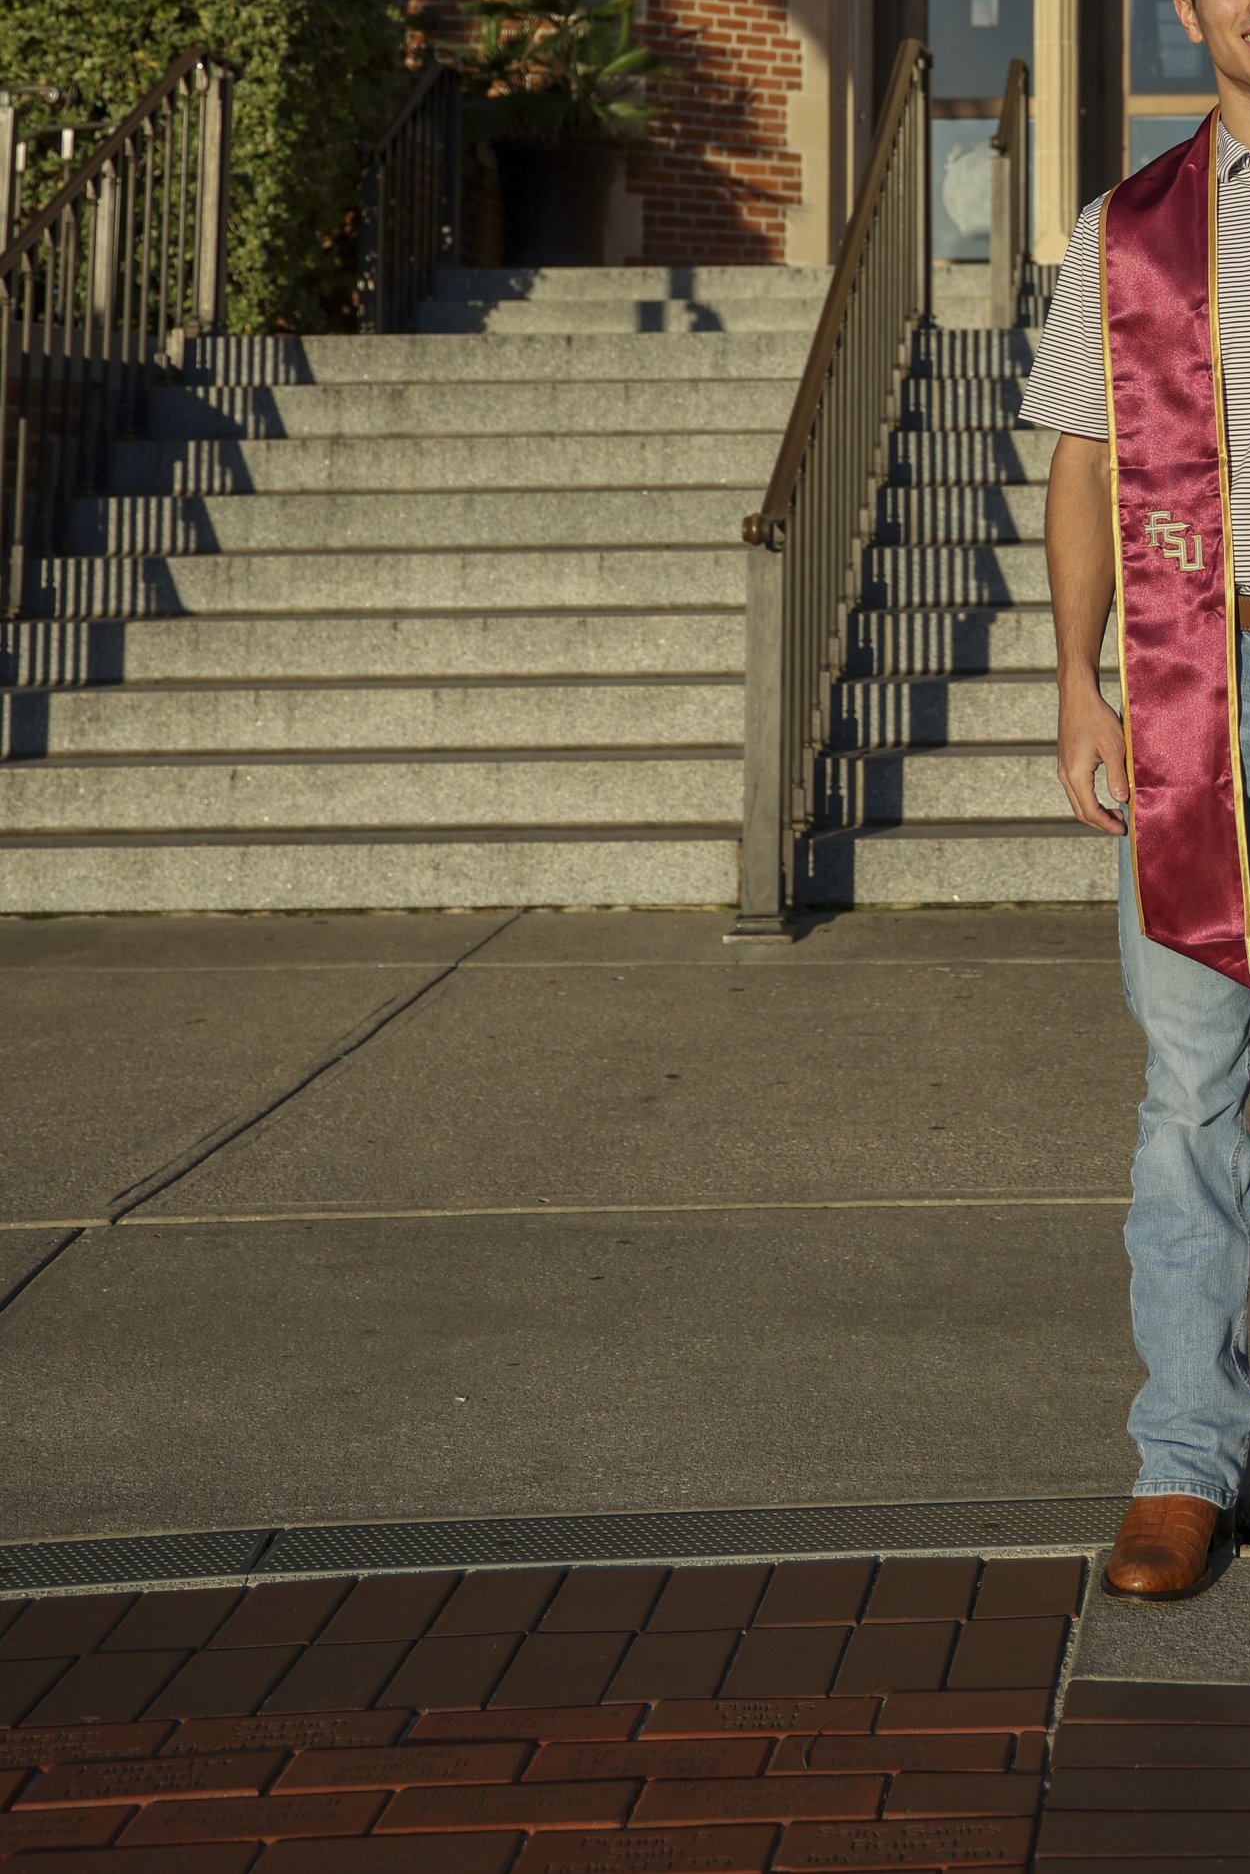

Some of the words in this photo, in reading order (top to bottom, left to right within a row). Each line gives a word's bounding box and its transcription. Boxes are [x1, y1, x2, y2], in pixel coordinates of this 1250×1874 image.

[1143, 510, 1206, 572] FSU
[815, 1826, 885, 1838] Sally
[903, 1824, 1001, 1836] Gavins
[850, 1837, 960, 1850] Retired
[606, 1846, 686, 1859] Smith
